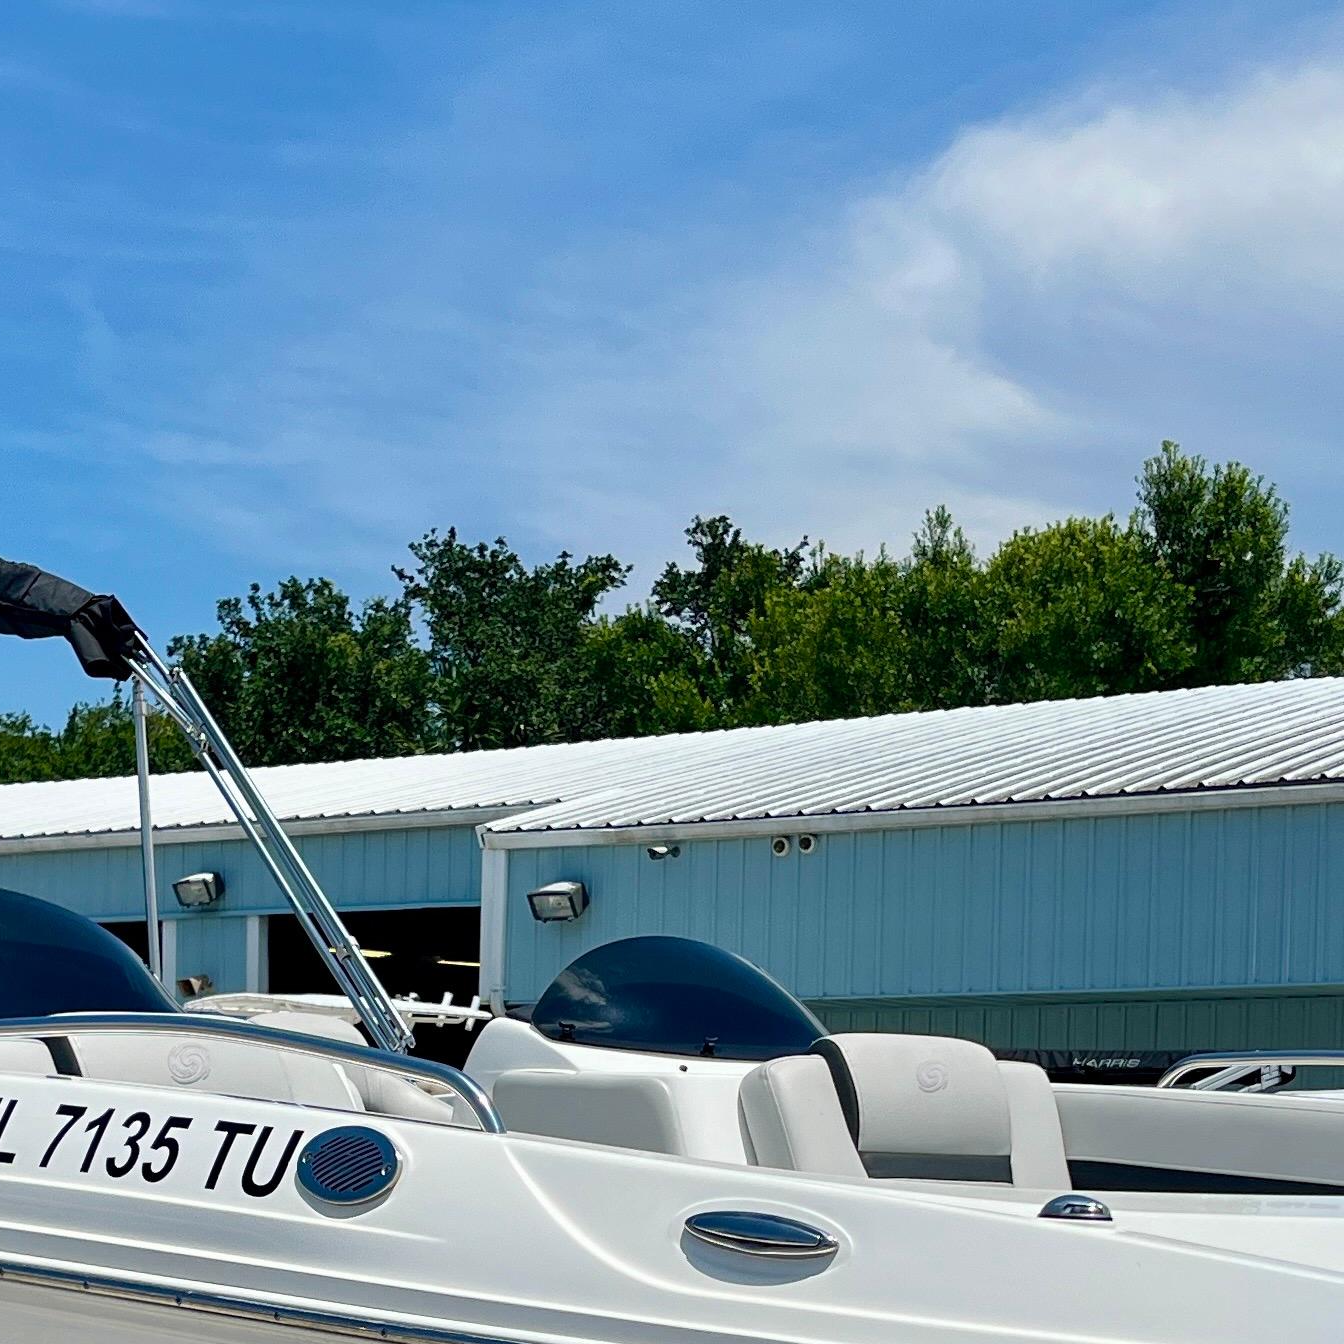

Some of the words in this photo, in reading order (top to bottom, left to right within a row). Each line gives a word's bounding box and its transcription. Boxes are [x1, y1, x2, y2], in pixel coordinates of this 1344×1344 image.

[1072, 1057, 1141, 1069] HARRIS
[39, 1104, 193, 1183] 7135
[204, 1120, 304, 1197] TU
